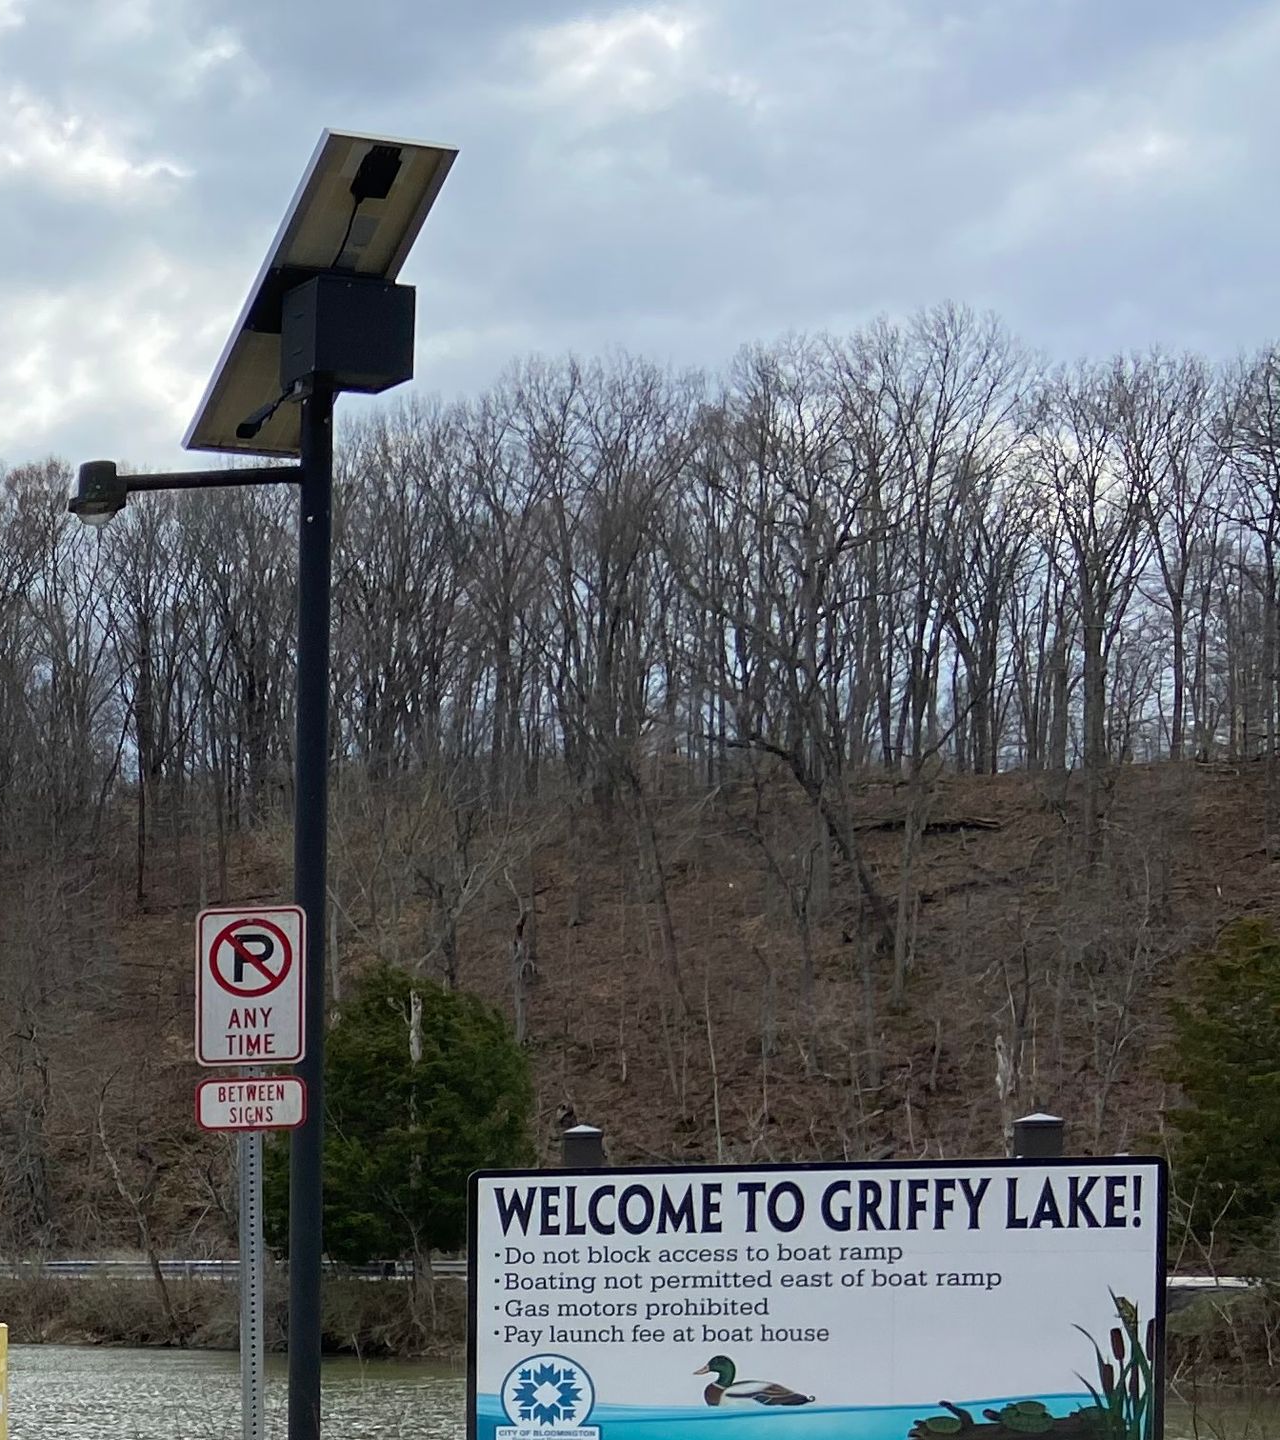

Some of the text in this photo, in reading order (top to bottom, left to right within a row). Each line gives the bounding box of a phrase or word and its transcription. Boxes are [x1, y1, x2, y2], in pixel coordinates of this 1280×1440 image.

[228, 1007, 272, 1029] ANY
[225, 1034, 275, 1055] TIME
[218, 1084, 284, 1102] BETWEEN
[229, 1107, 273, 1124] SIGNS
[494, 1175, 1142, 1237] WELCOME TO GRIFFY LAKE!
[504, 1244, 903, 1265] Do not block access to boat ramp
[504, 1269, 1002, 1294] Boating not permitted east of boat ramp
[505, 1298, 769, 1320] Gas motors prohibited
[504, 1324, 829, 1346] Pay launch fee at boat house
